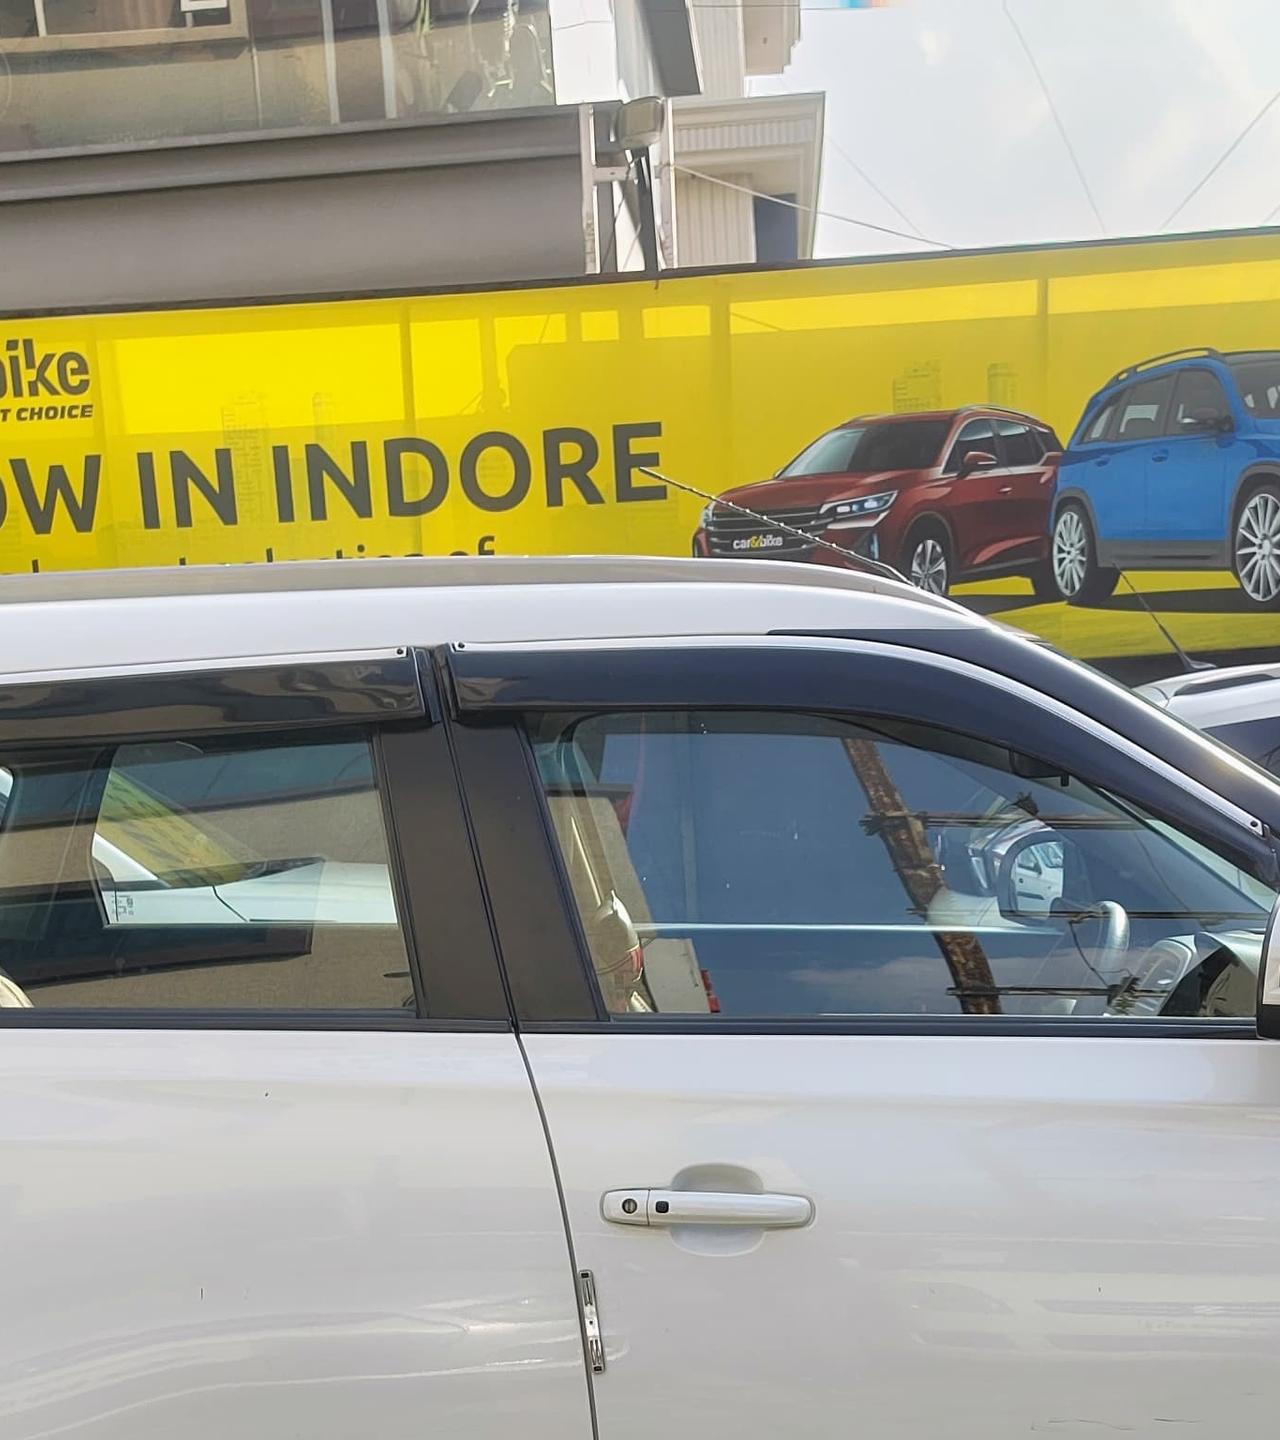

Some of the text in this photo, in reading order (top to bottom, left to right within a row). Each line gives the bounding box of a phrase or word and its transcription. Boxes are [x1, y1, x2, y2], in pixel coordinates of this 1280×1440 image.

[16, 403, 95, 422] CHOICE
[138, 447, 238, 530] IN
[273, 421, 669, 523] INDORE
